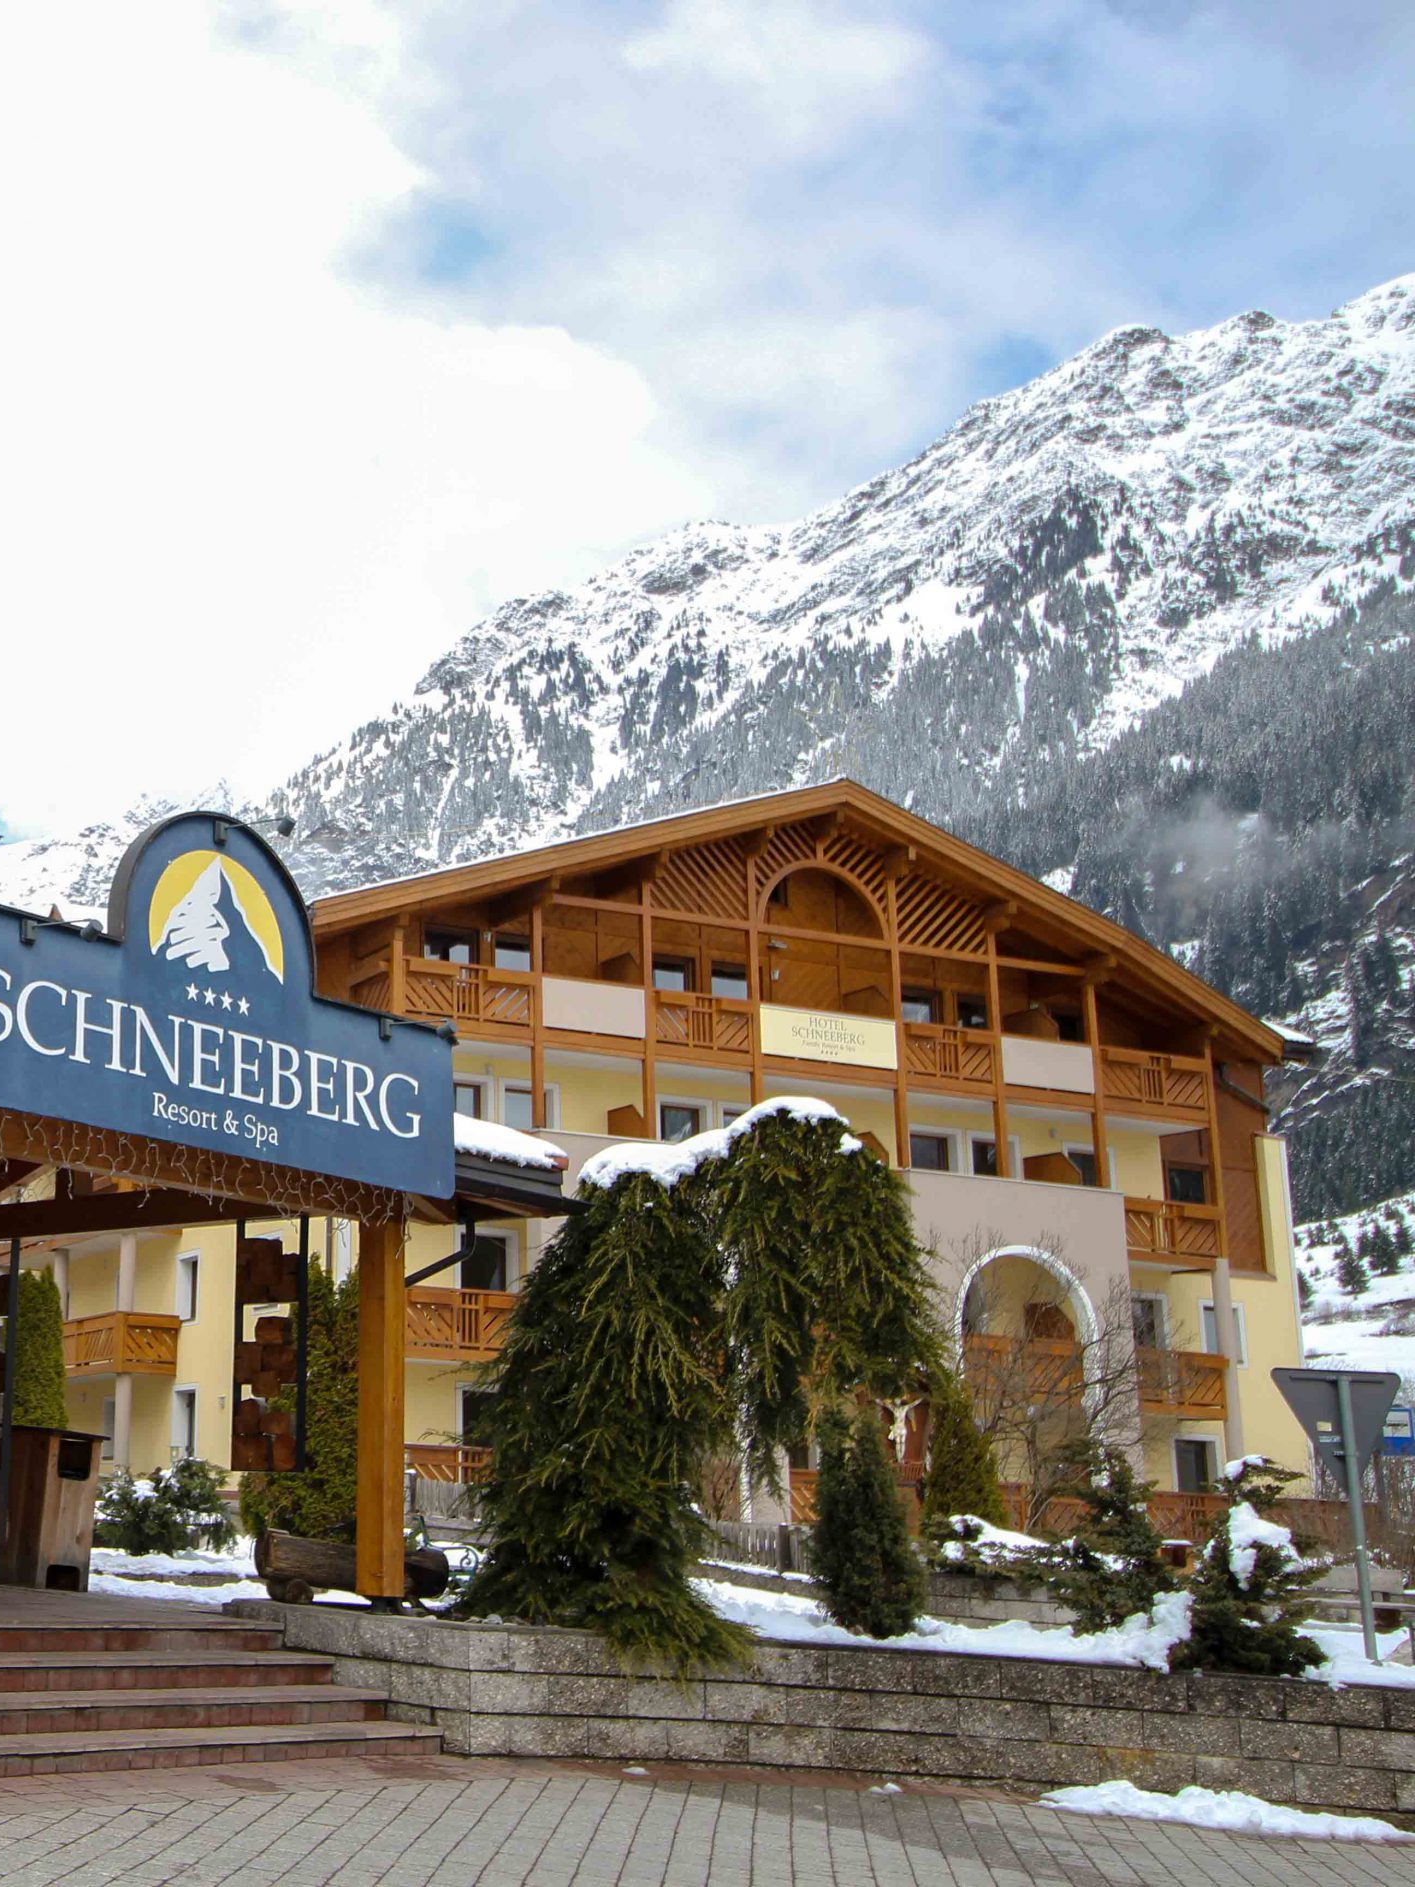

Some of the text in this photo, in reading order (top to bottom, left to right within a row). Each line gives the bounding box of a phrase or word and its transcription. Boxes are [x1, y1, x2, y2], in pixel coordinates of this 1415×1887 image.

[809, 1016, 847, 1031] HOTEL
[791, 1026, 865, 1045] SCHNEEBERG
[152, 1092, 279, 1148] Resort & Spa
